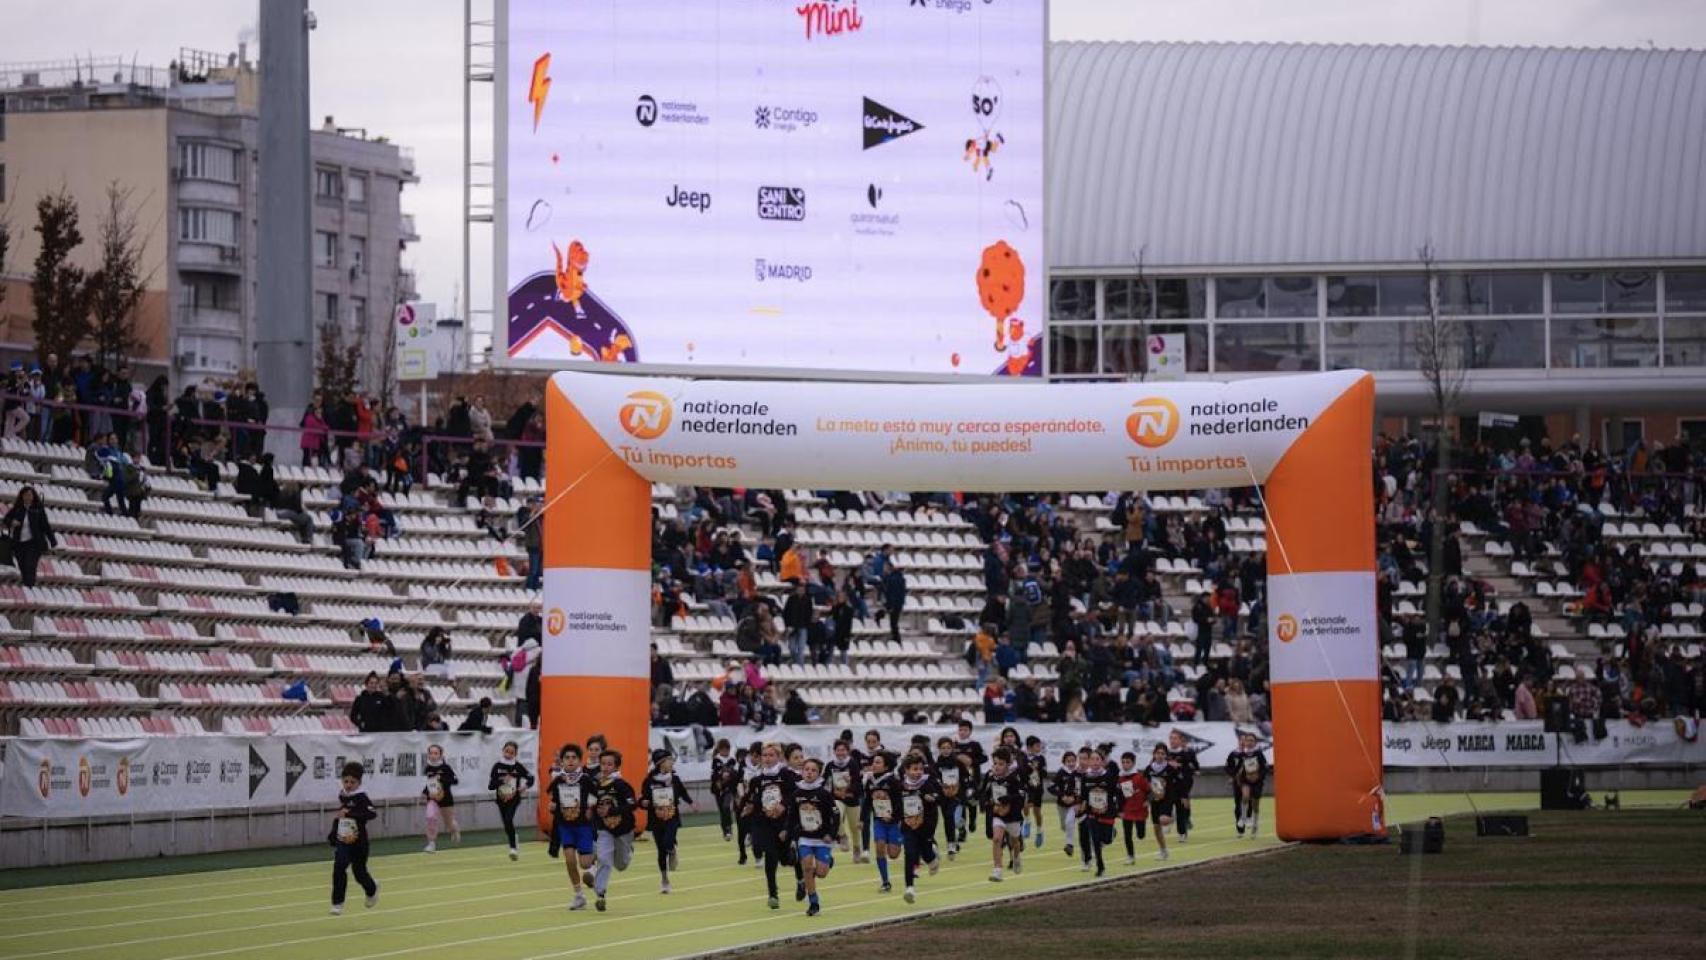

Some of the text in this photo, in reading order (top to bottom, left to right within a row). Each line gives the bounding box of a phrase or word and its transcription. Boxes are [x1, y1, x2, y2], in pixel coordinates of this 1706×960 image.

[661, 112, 710, 125] nederlanden
[773, 106, 818, 126] Contigo
[667, 184, 711, 213] Jeep
[760, 188, 786, 203] SANI
[760, 202, 804, 219] CENTRO
[768, 265, 813, 281] MADRID
[682, 400, 769, 416] nationale
[1190, 398, 1279, 416] nationale
[681, 416, 798, 436] nederlanden
[816, 417, 1106, 437] La meta está muy cerca esperándote.
[1190, 414, 1309, 436] nederlanden
[971, 438, 1032, 454] puedes!
[620, 446, 738, 469] Tú importas
[1128, 454, 1248, 474] Tú importas
[569, 611, 613, 621] nationale
[569, 621, 628, 632] nederlanden
[1384, 735, 1412, 752] Jeep
[1421, 735, 1451, 752] Jeep
[1457, 735, 1495, 751] MARCA
[1506, 735, 1546, 750] MARCA
